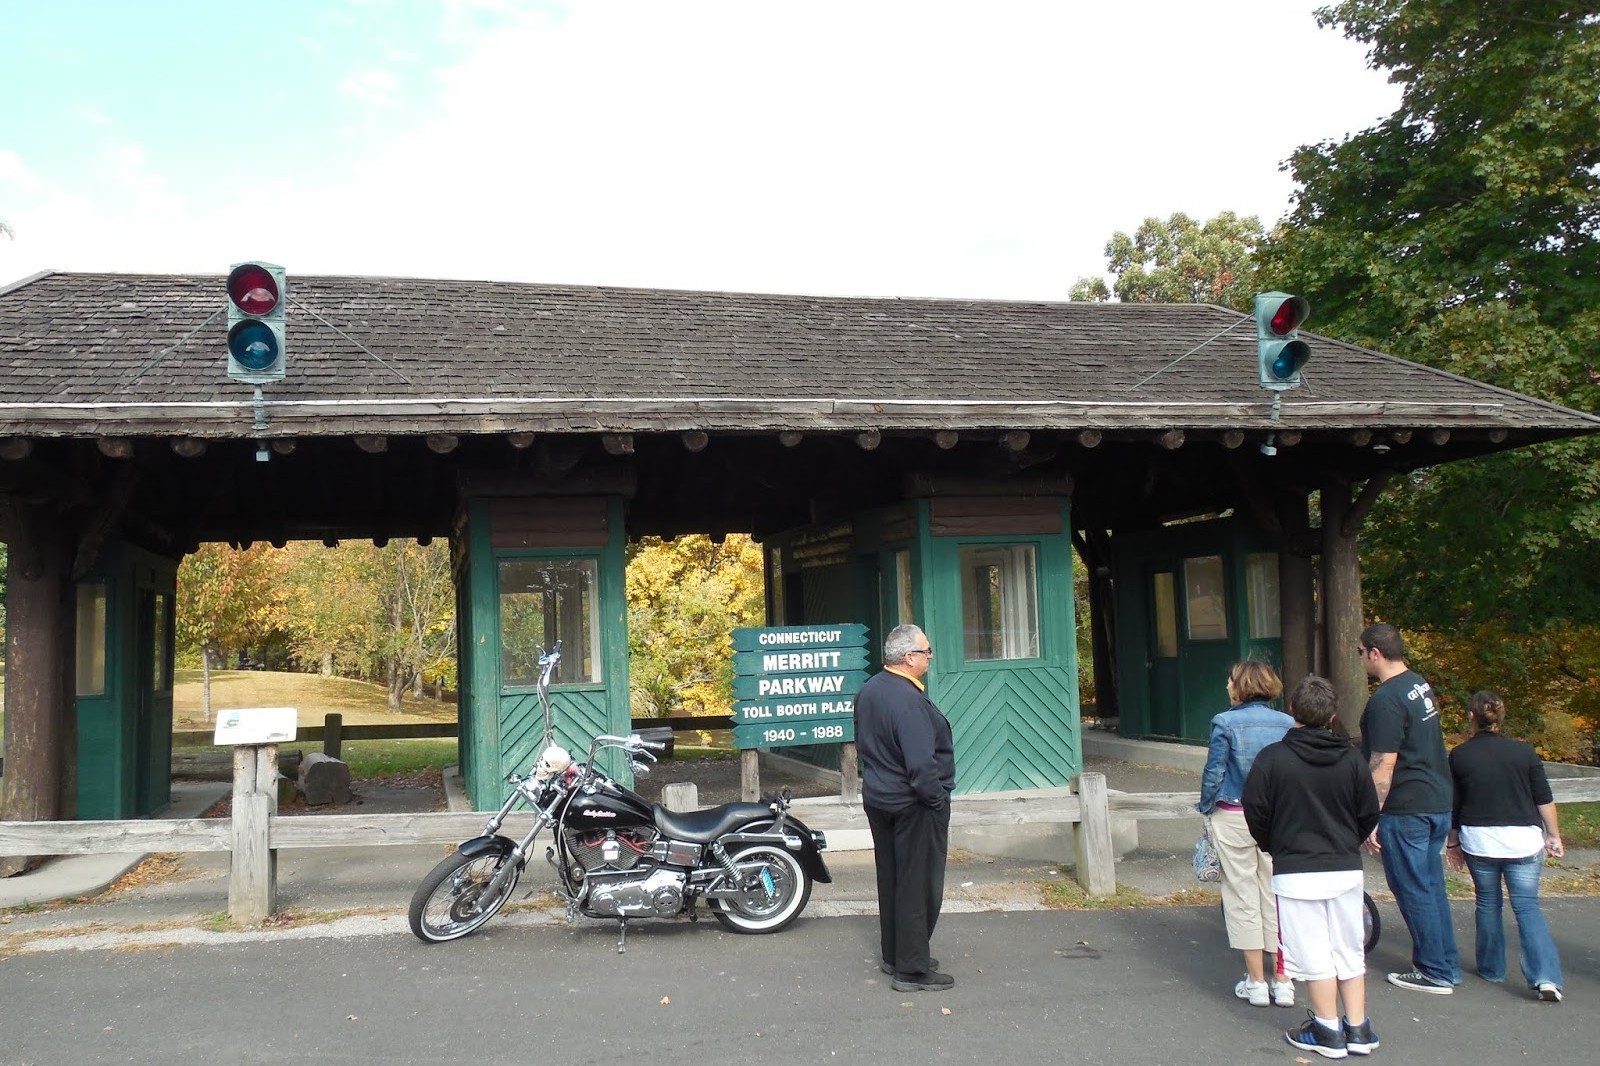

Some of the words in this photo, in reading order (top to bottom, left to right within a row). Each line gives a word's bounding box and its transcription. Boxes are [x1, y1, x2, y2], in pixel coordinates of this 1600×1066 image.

[759, 631, 842, 645] CONNECTICUT
[763, 652, 841, 671] MERRITT
[759, 676, 845, 695] PARKWAY
[742, 706, 772, 719] TOLL
[776, 703, 817, 717] BOOTH
[821, 701, 854, 714] PLAZ
[763, 729, 795, 742] 1940
[812, 725, 844, 739] 1988
